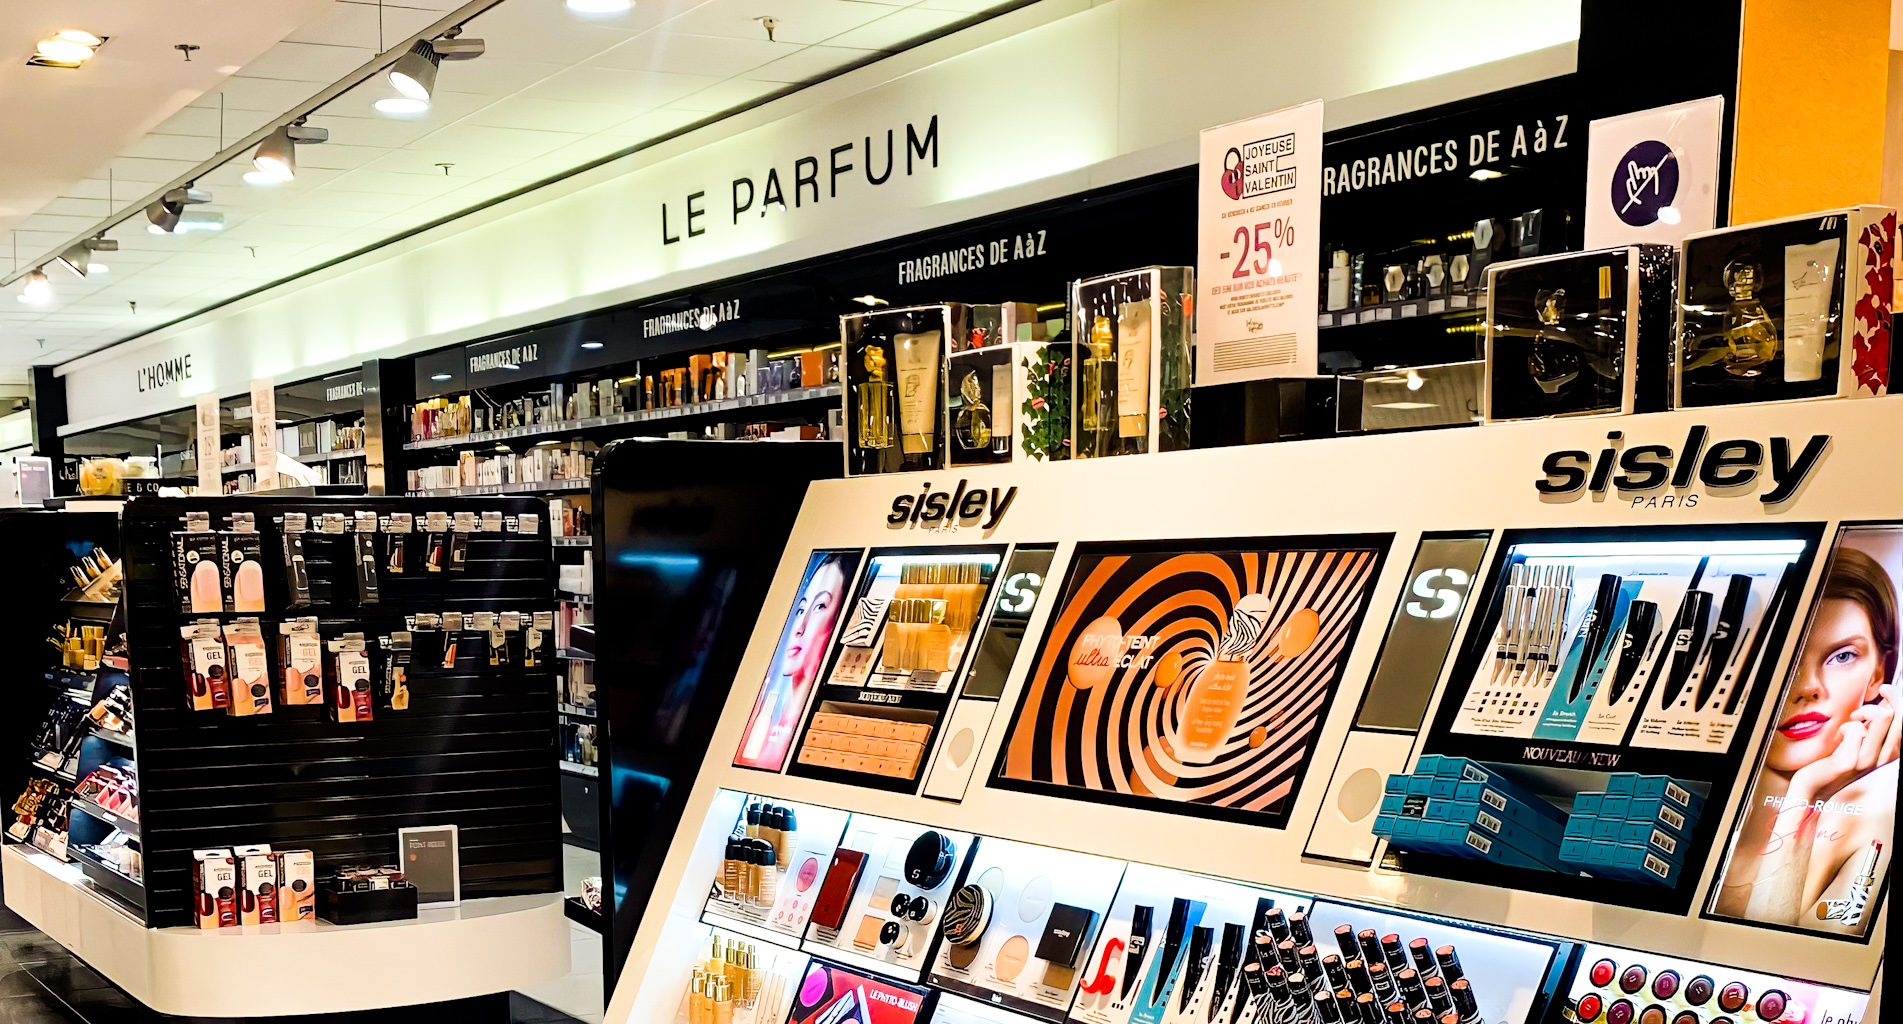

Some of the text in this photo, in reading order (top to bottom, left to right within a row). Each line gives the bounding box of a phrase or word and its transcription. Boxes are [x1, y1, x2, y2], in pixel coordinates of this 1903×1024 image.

[1245, 138, 1293, 161] JOYEUSE
[1245, 159, 1275, 177] SAINT
[1323, 139, 1458, 197] RAGRANCES
[1469, 129, 1501, 167] DE
[662, 114, 939, 245] LE PARFUM
[1244, 172, 1295, 194] VALENTIN
[1220, 216, 1295, 279] -25%
[898, 241, 985, 286] FRAGRANCES
[989, 237, 1009, 265] DE
[643, 307, 700, 339] FRAGRANCES
[137, 353, 192, 393] L'HOMME
[469, 350, 511, 373] FRAGRANCES
[1535, 425, 1833, 506] sisley
[886, 478, 1019, 531] sisley
[1631, 493, 1699, 510] PARIS
[999, 572, 1041, 613] S
[1405, 567, 1470, 620] S
[1081, 633, 1161, 651] PHYTO-TEINT
[206, 651, 223, 660] GEL
[352, 666, 368, 675] GEL
[1522, 746, 1582, 764] NOUVEAU
[1590, 751, 1622, 767] NEW
[1763, 795, 1865, 817] PHO-ROUGE
[216, 872, 233, 882] GEL
[258, 869, 274, 879] GEL
